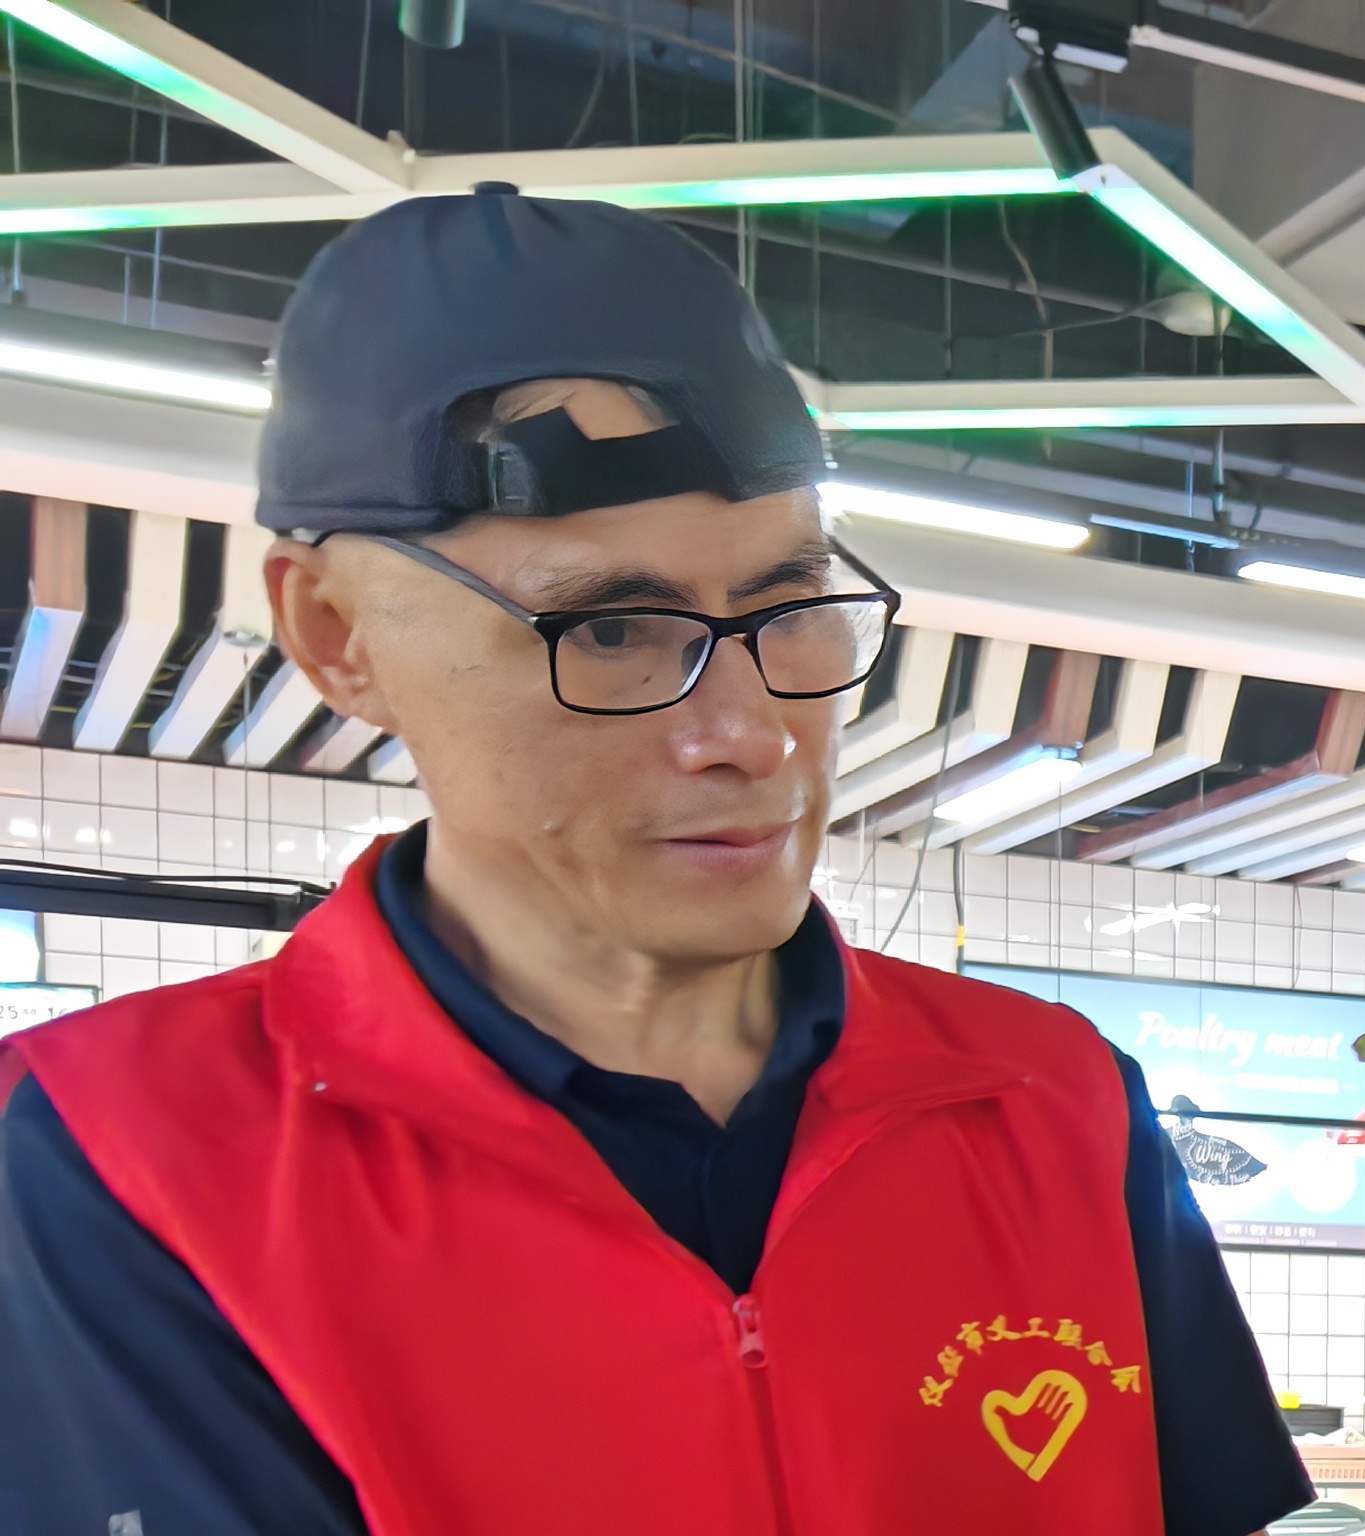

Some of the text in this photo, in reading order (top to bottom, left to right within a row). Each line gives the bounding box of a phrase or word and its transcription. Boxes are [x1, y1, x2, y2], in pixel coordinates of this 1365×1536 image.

[1136, 1010, 1344, 1067] Poultry meat
[1195, 1142, 1232, 1172] Wing
